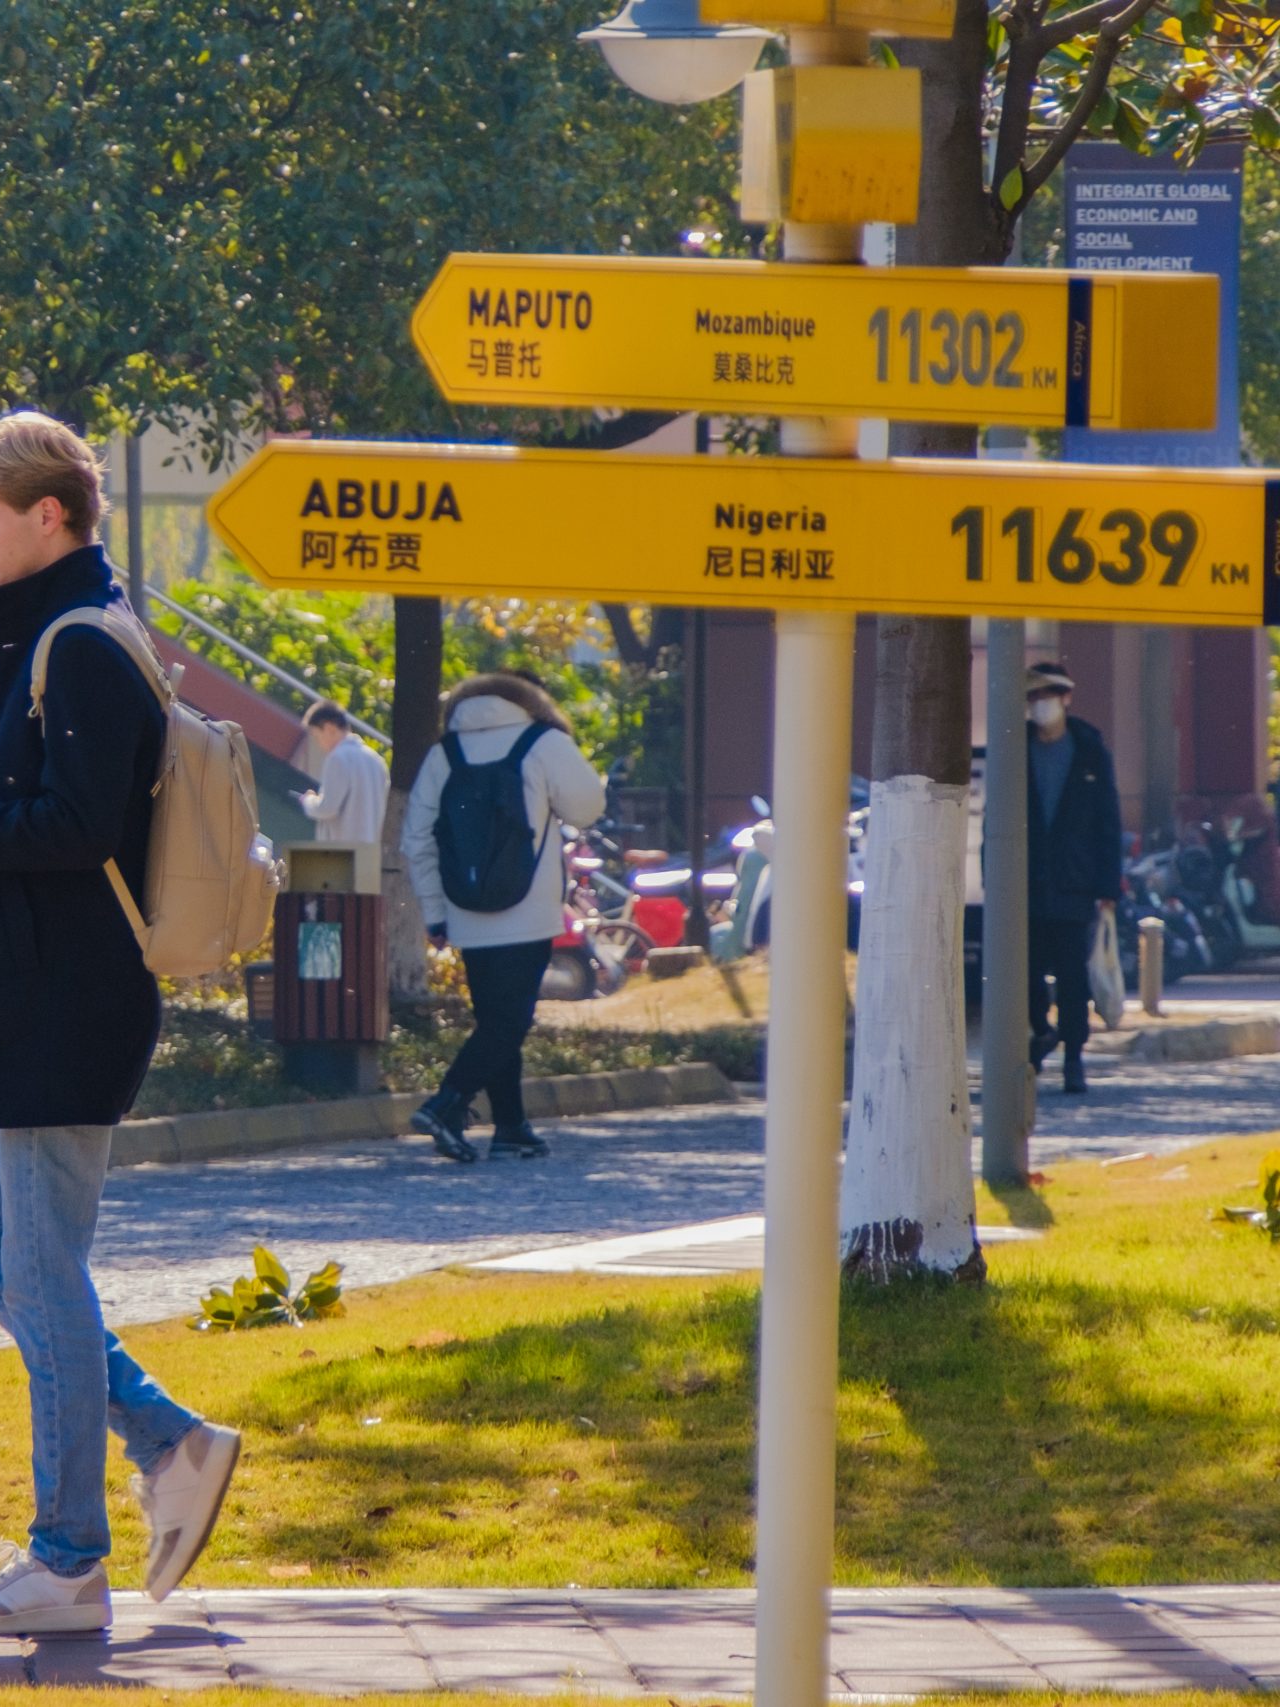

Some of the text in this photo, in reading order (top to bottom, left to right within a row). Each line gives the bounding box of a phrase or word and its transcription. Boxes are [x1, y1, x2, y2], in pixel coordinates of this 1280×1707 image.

[1076, 184, 1232, 200] INTEGRATE GLOBAL
[1076, 209, 1198, 223] ECONOMIC AND
[1075, 233, 1133, 247] SOCIAL
[1076, 256, 1193, 270] DEVELOPMENT
[468, 288, 592, 329] MAPUTO
[695, 309, 816, 341] Mozambique
[467, 340, 541, 378] 马普托
[868, 307, 1058, 389] 11302 KM
[713, 353, 795, 385] 莫桑比克
[301, 478, 462, 521] ABUJA
[715, 503, 827, 535] Nigeria
[301, 531, 422, 572] 阿布贾
[951, 505, 1250, 586] 11639 KM
[704, 545, 835, 580] 尼日利亚
